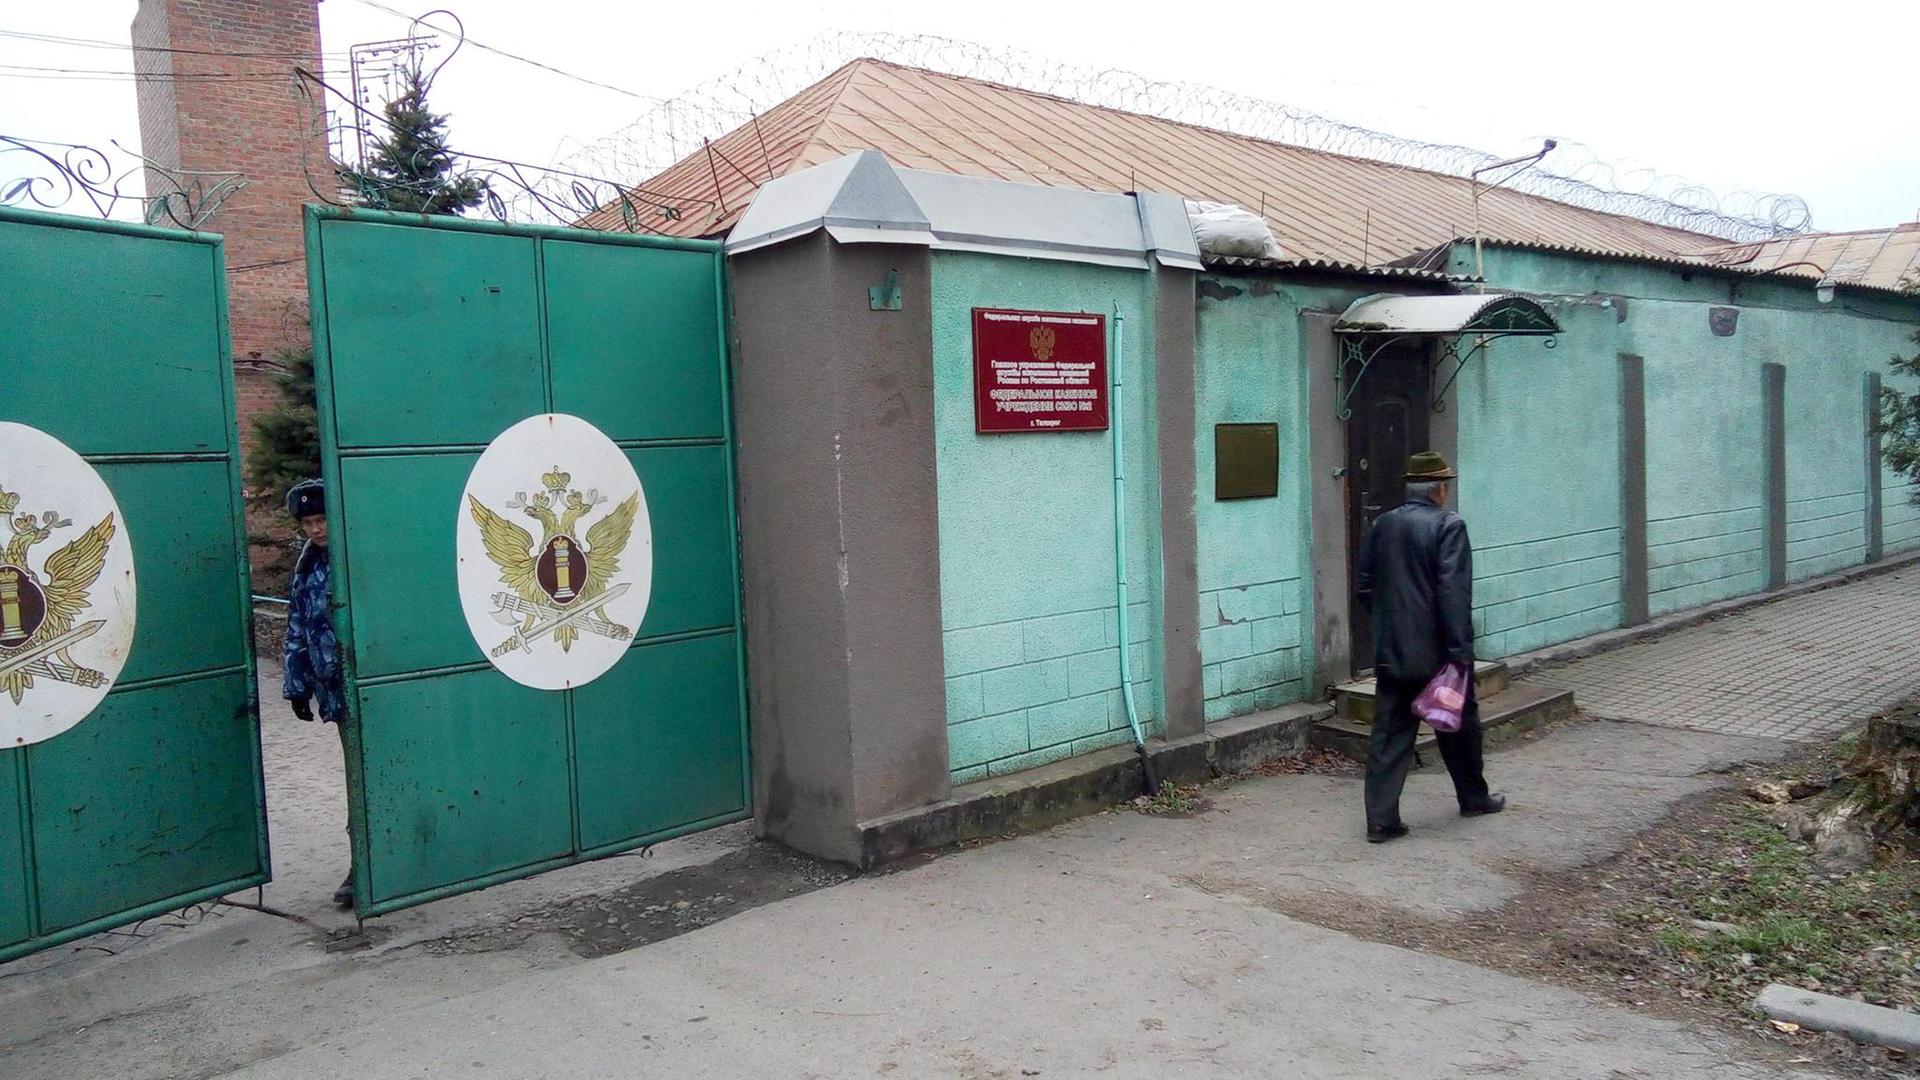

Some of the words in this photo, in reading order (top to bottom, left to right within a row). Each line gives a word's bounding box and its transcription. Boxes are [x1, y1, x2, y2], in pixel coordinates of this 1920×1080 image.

[990, 389, 1054, 401] ФЕДЕРАЛЬНОЕ
[996, 401, 1054, 413] УЧРЕЖДЕНИЕ
[1055, 400, 1078, 411] СИЗО
